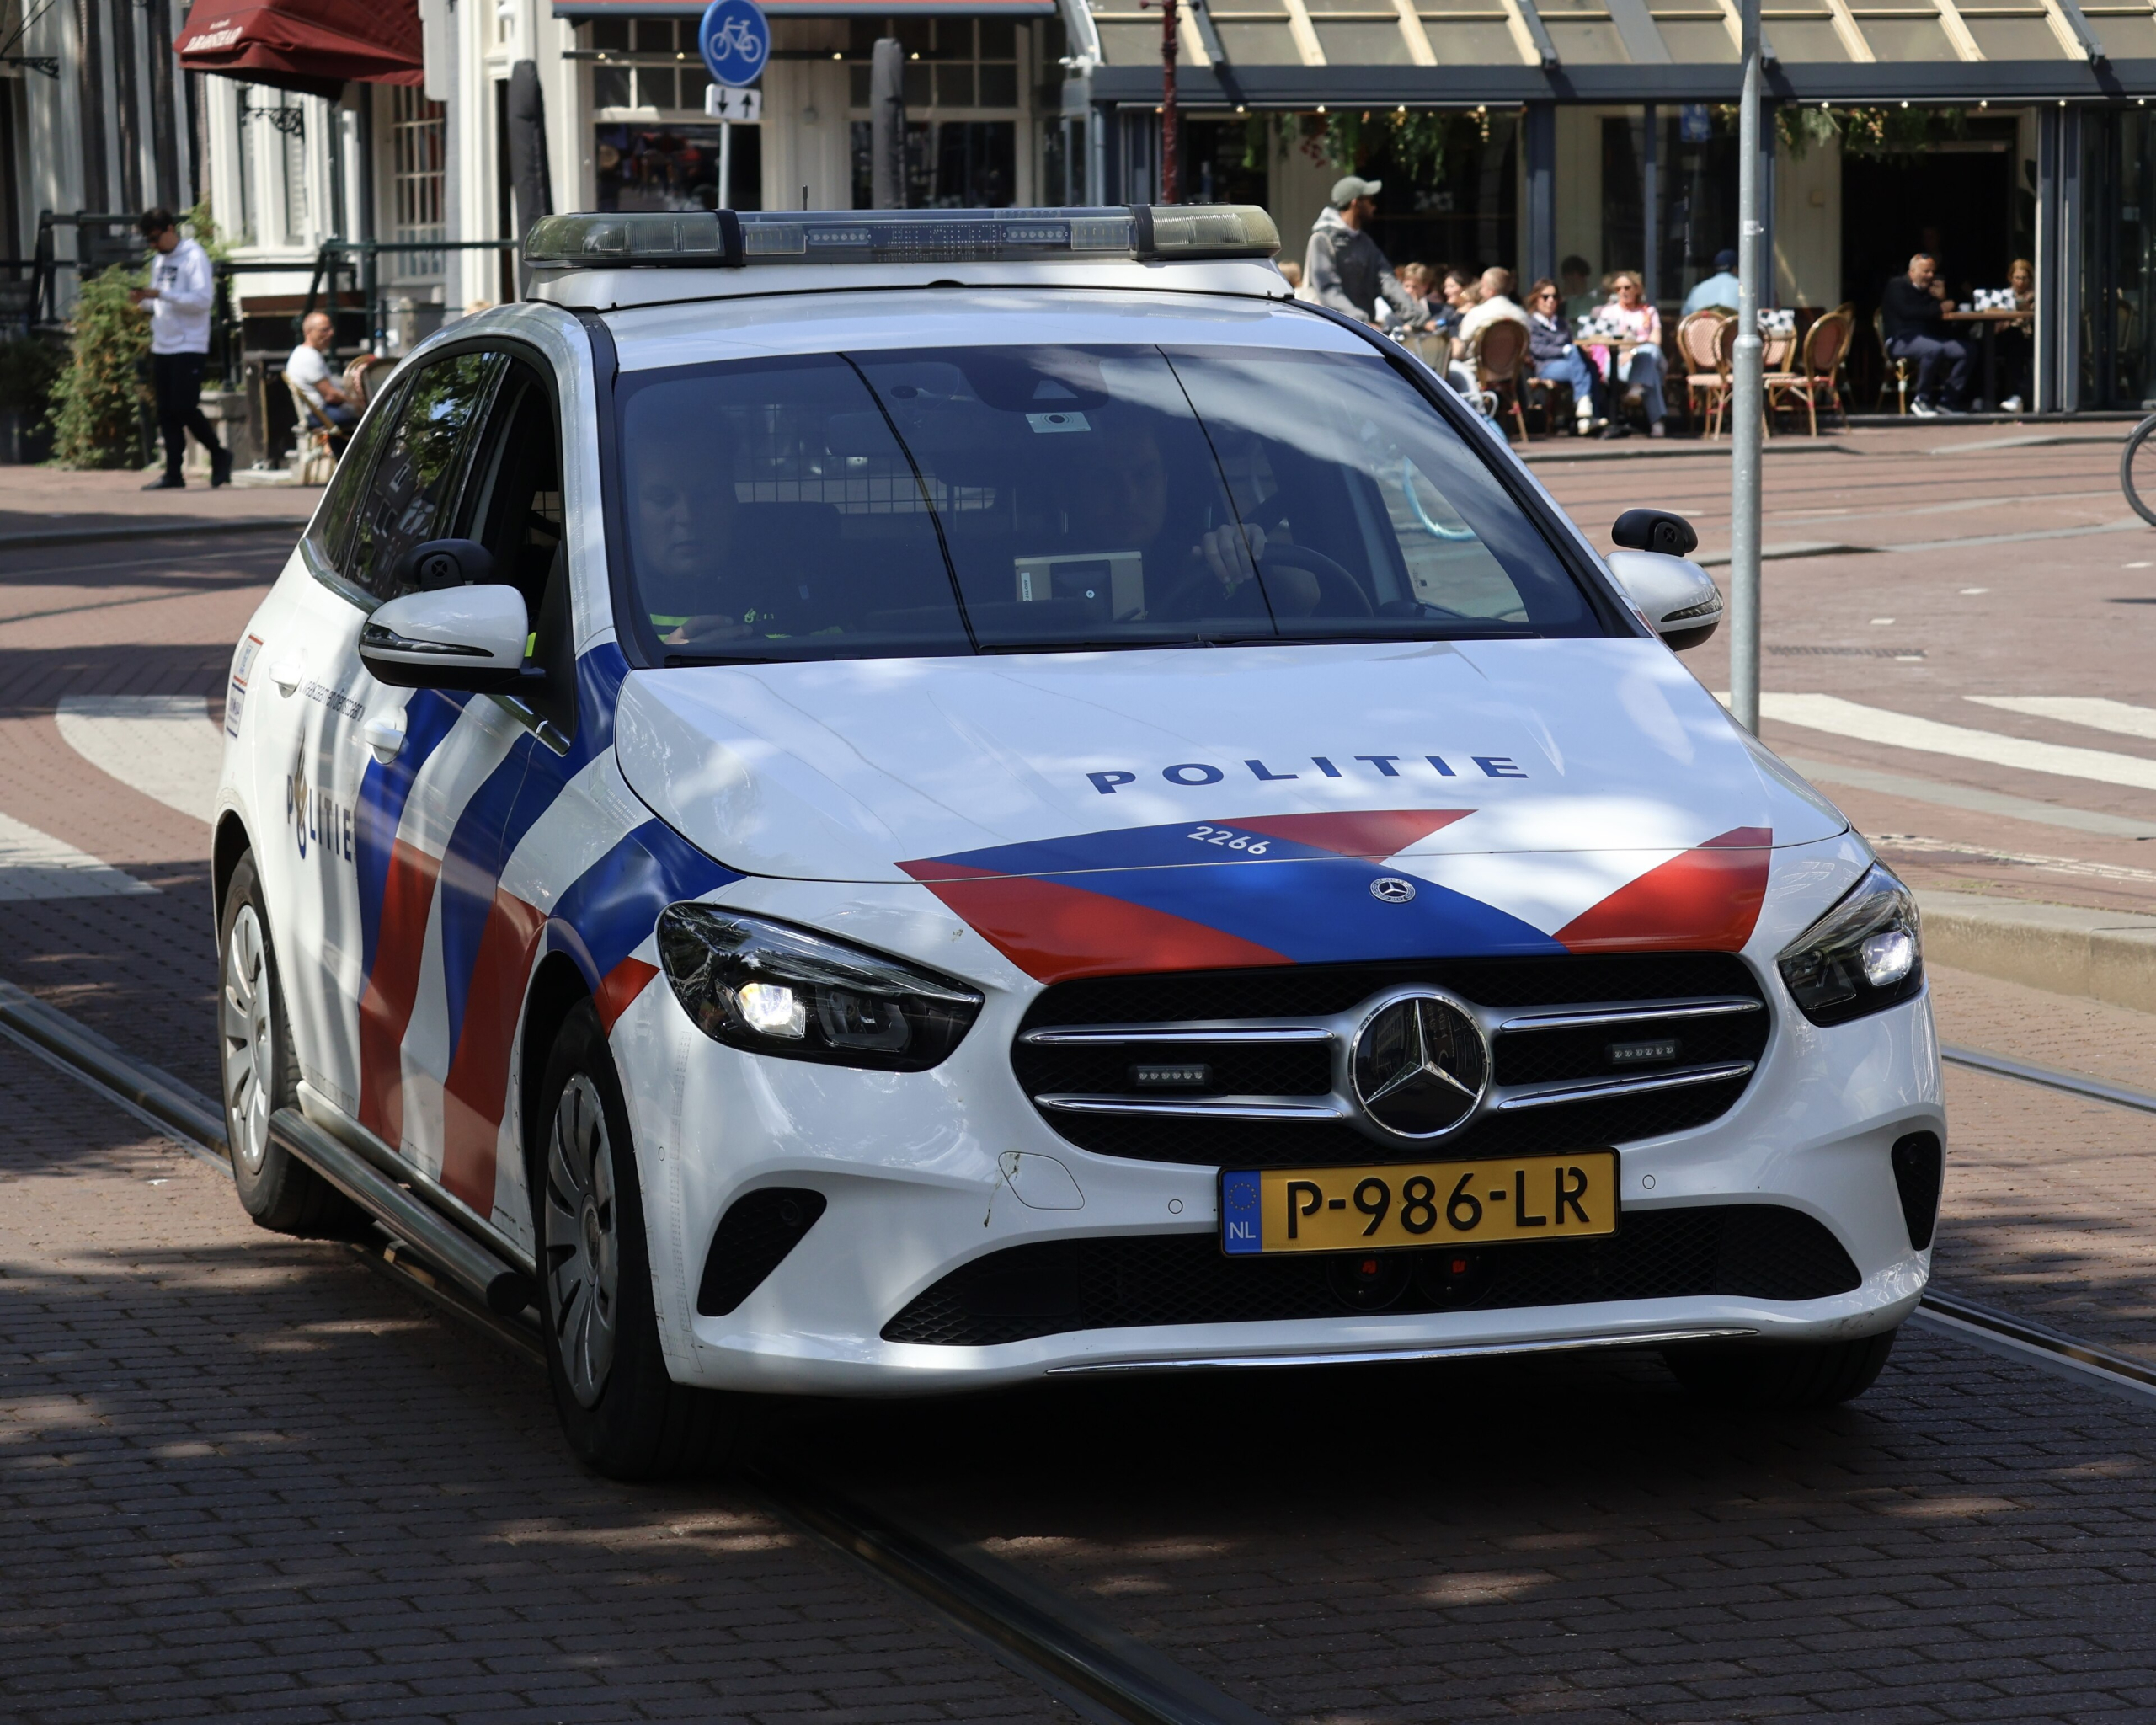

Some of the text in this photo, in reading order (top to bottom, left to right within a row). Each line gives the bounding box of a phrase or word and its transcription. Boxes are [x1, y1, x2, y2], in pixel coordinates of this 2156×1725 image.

[1086, 756, 1529, 794] POLITIE
[1187, 825, 1271, 854] 2266
[1287, 1167, 1590, 1239] P-986-LR
[1229, 1221, 1257, 1239] NL
